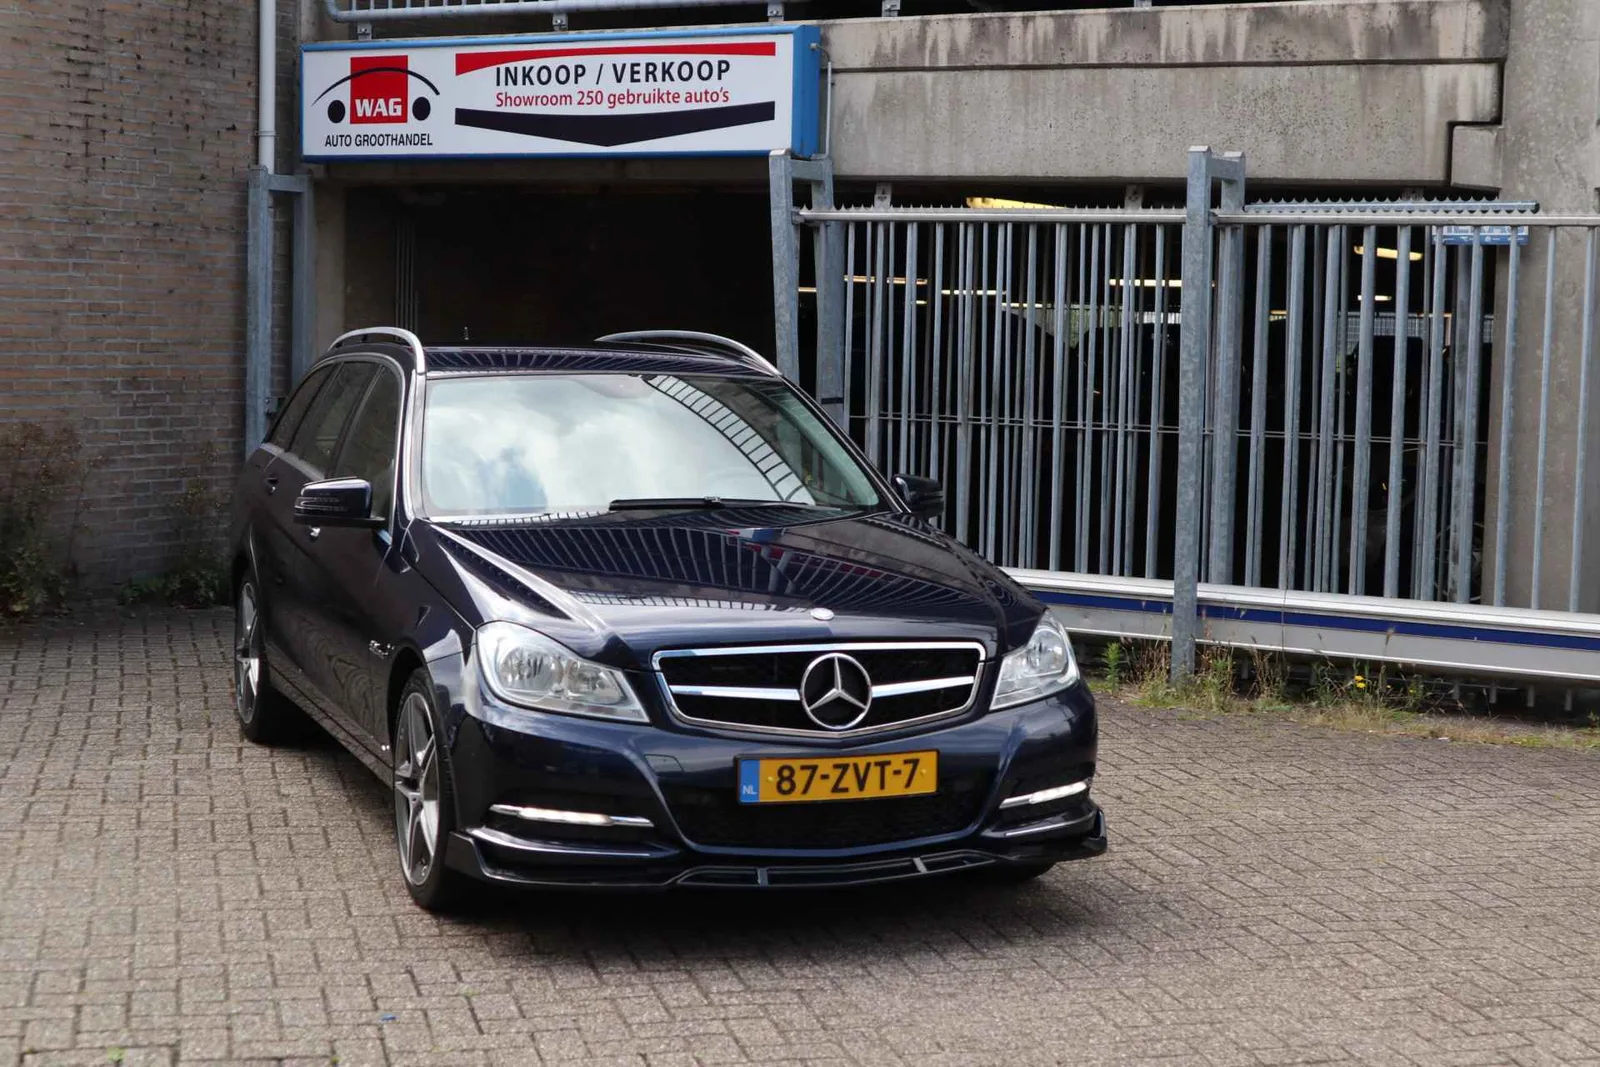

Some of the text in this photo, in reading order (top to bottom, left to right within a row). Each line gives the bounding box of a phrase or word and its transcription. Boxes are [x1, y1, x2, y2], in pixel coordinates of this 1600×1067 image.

[496, 59, 730, 87] INKOOP / VERKOOP
[355, 98, 402, 117] WAG
[496, 87, 730, 109] Showroom 250 gebruikte auto's
[325, 133, 433, 147] AUTO GROOTHANDEL
[776, 758, 919, 795] 87-ZVT-7
[742, 785, 757, 795] NL
